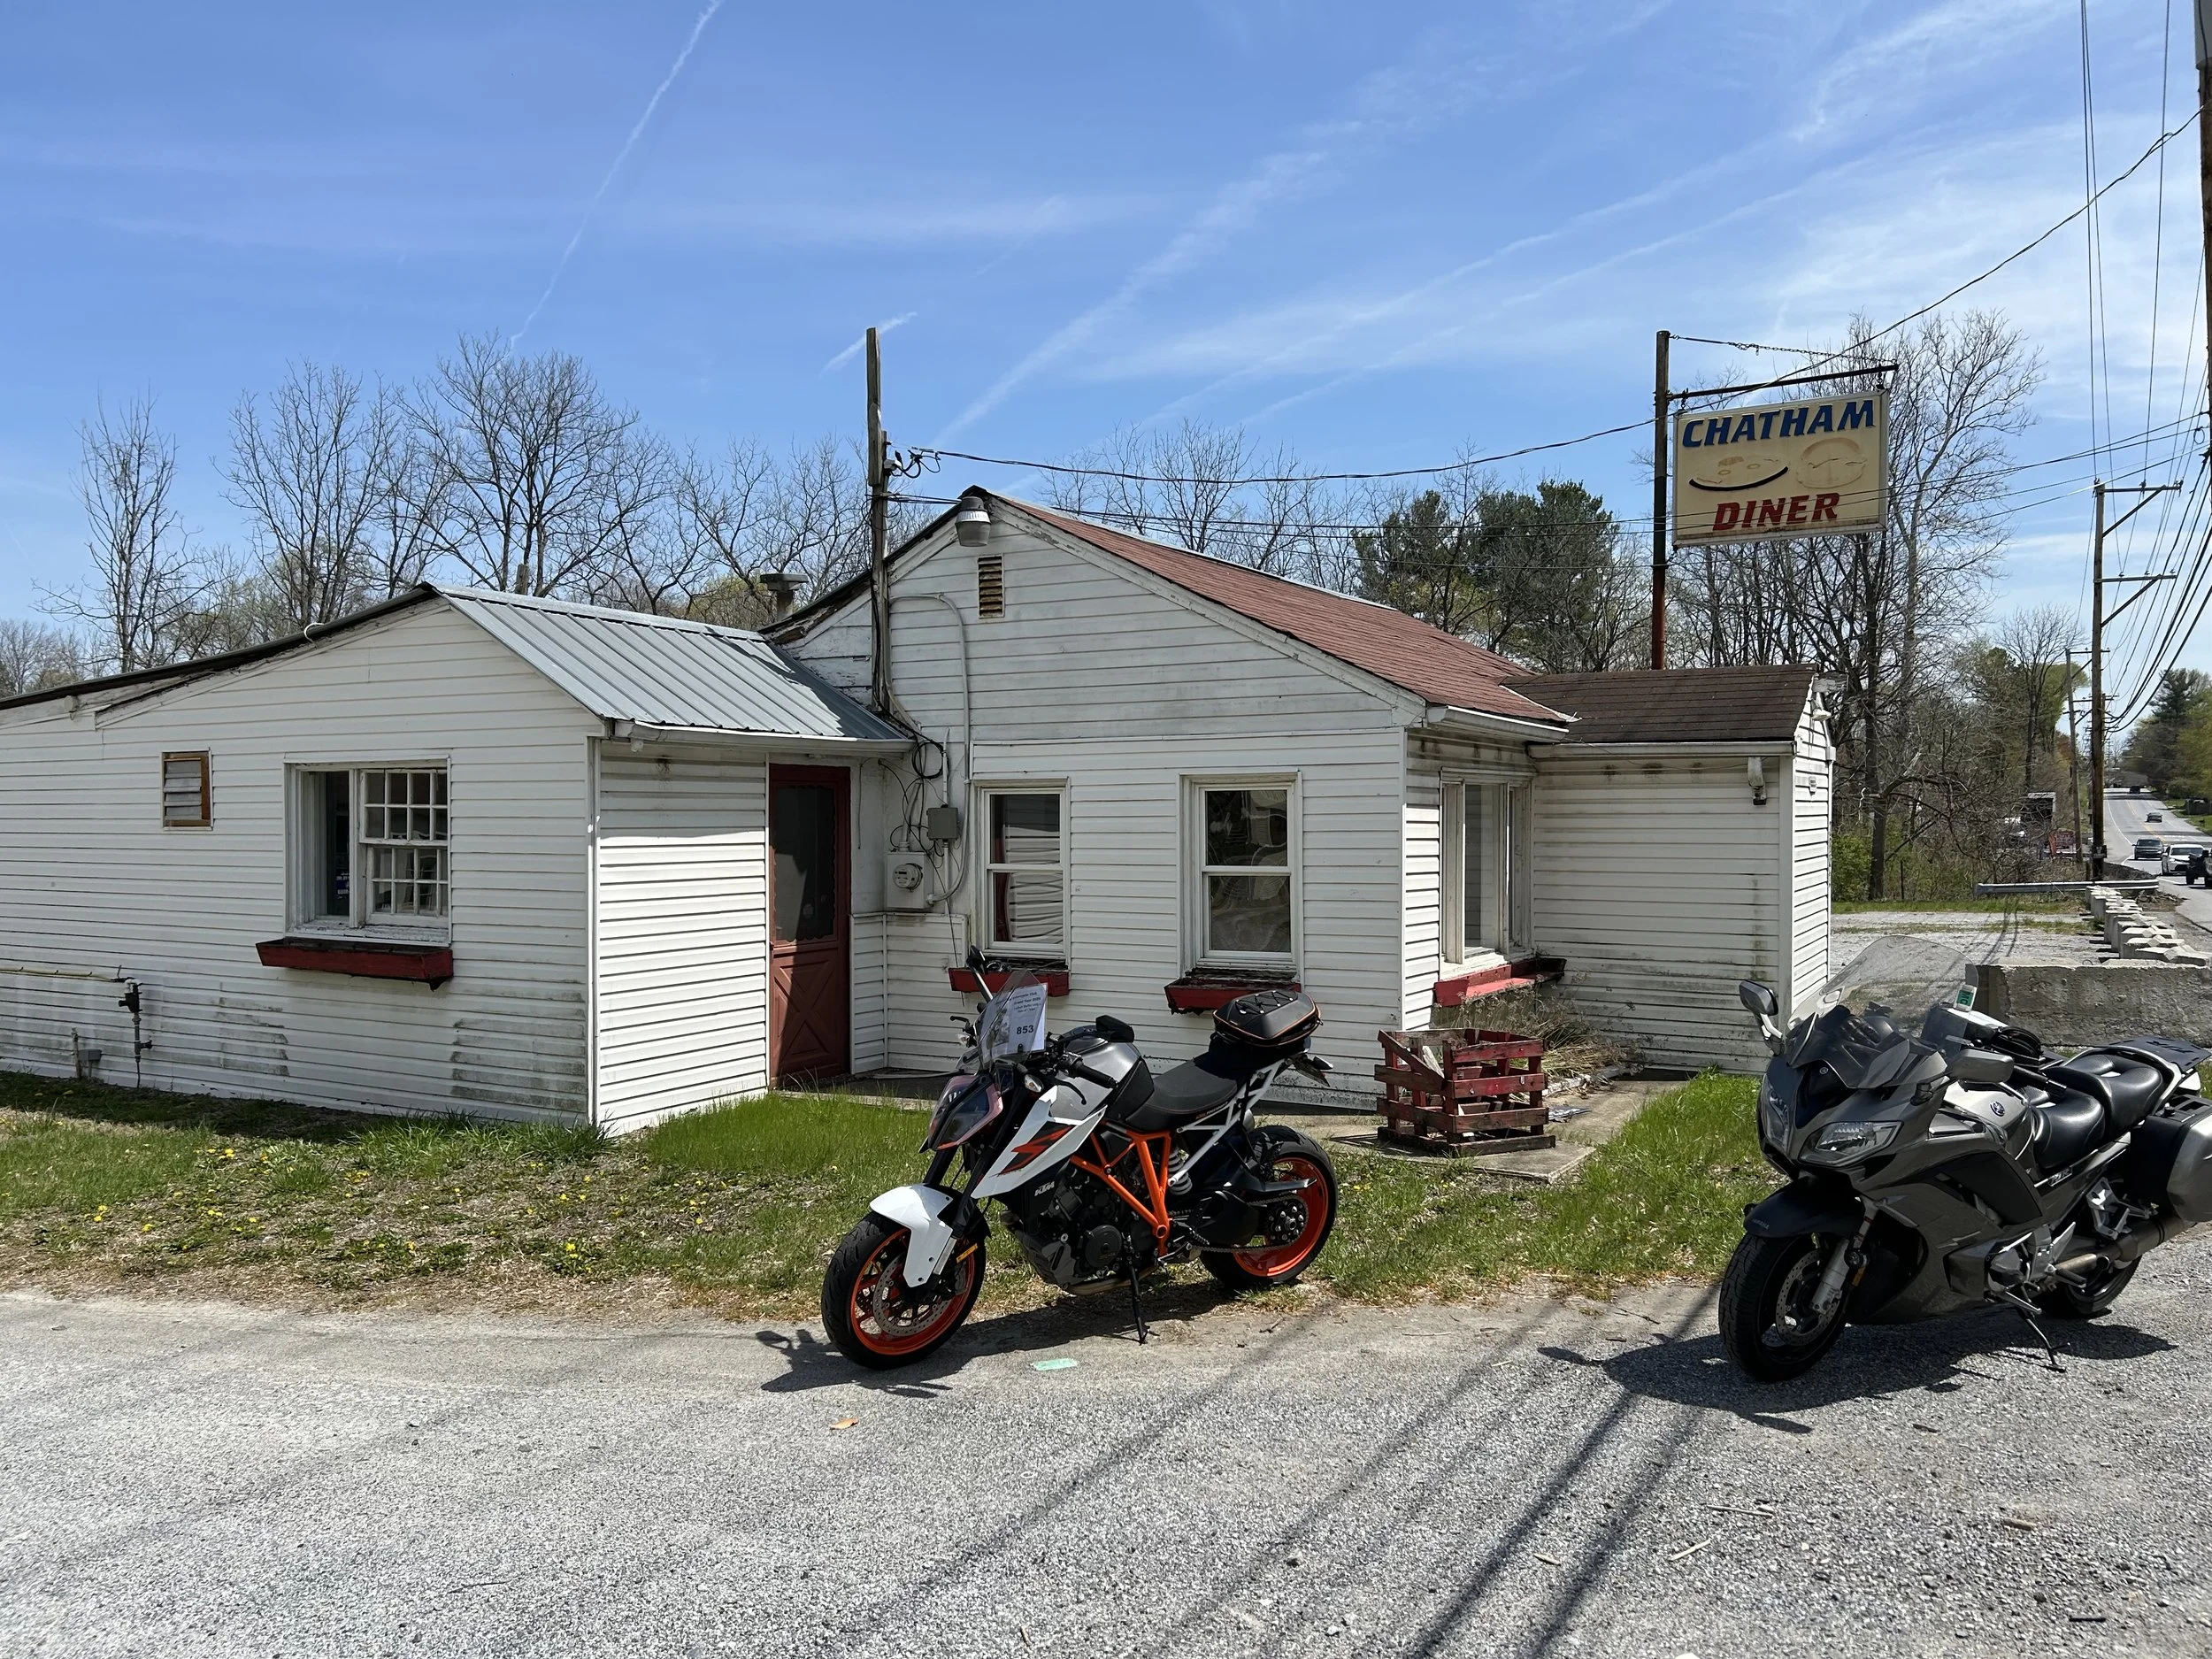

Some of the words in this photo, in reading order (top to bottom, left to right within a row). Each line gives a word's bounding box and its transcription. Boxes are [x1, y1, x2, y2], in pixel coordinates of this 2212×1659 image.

[1682, 399, 1875, 448] CHATHAM
[1712, 492, 1840, 531] DINER
[1959, 991, 1971, 1005] MC
[1016, 1025, 1034, 1035] 853
[1034, 1180, 1056, 1196] KTM
